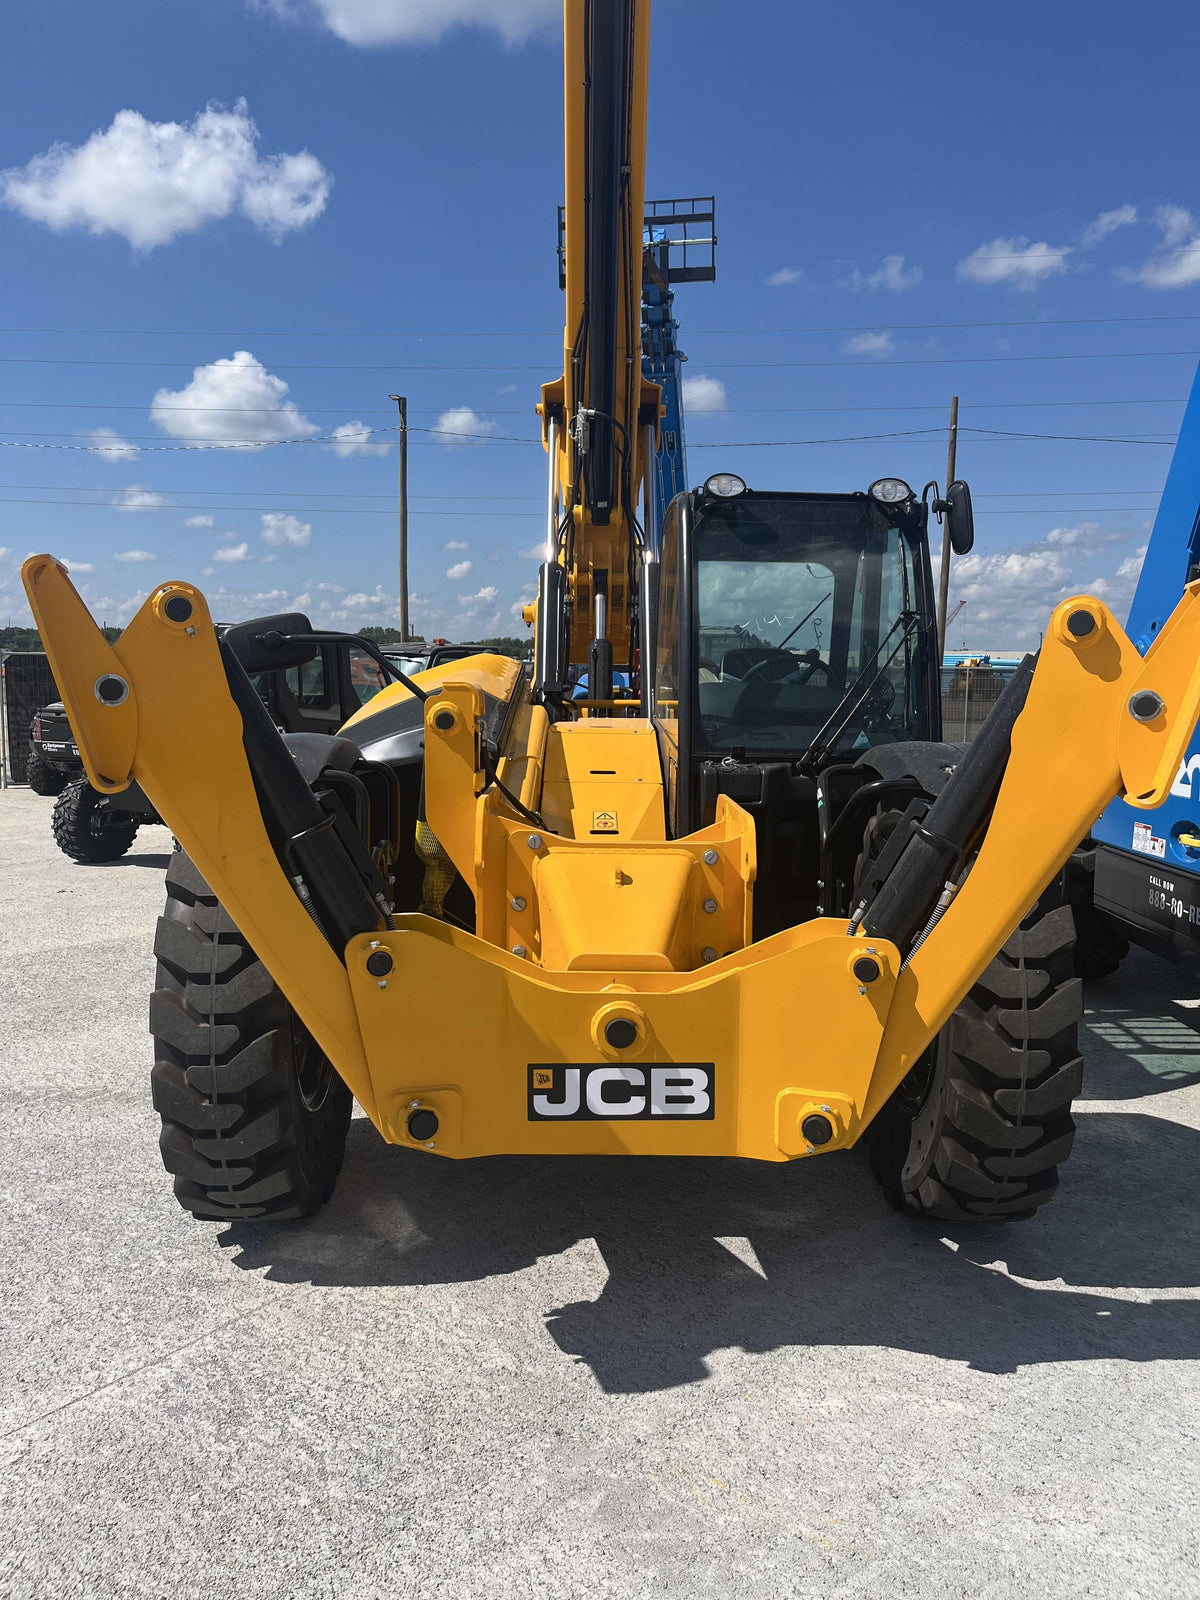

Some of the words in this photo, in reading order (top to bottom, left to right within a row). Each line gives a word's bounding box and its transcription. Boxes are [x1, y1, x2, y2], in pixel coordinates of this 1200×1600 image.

[1149, 875, 1161, 887] CALL
[1162, 880, 1174, 892] NOW
[533, 1067, 710, 1116] JCB
